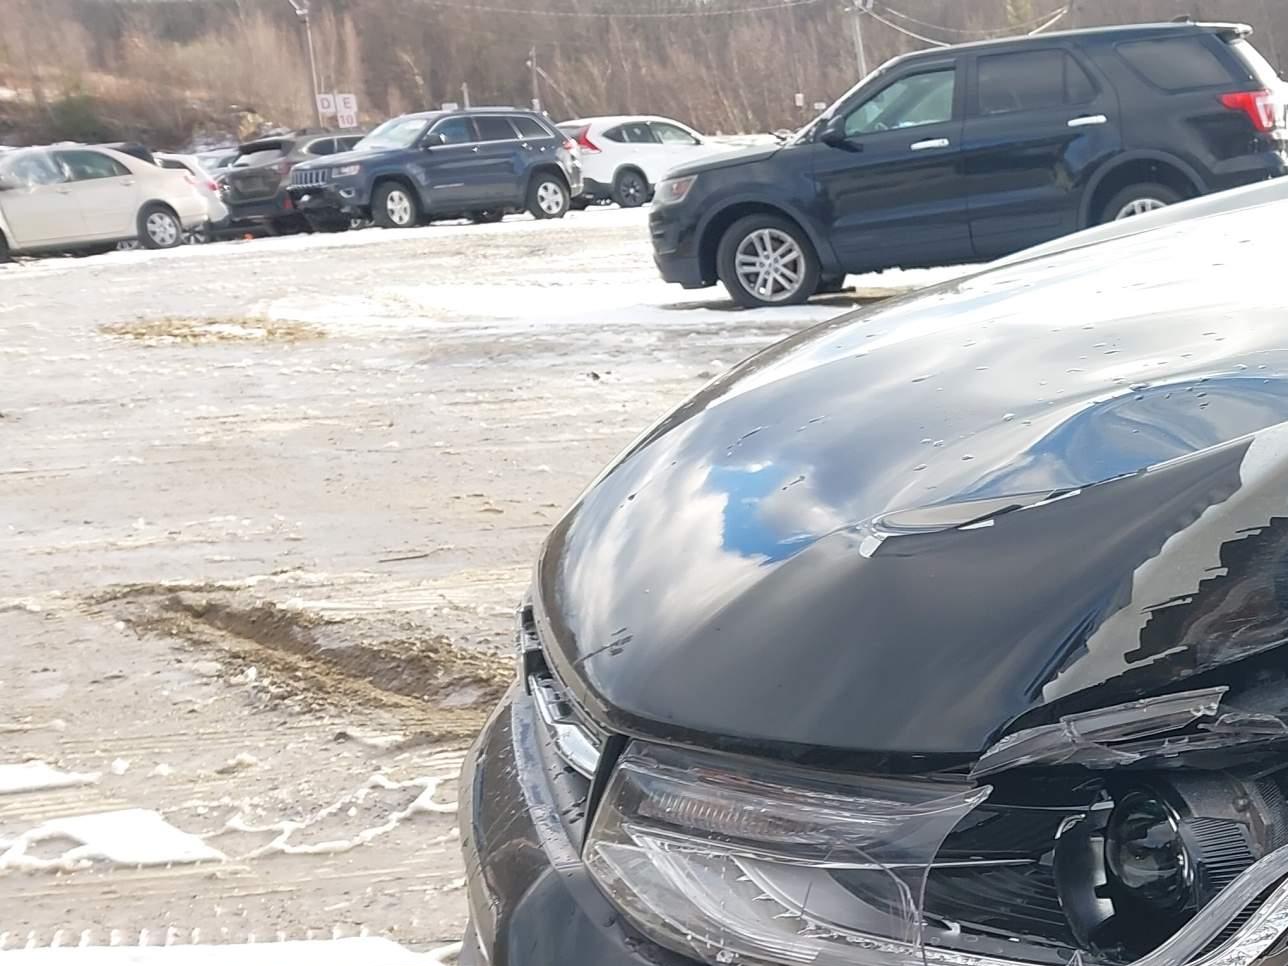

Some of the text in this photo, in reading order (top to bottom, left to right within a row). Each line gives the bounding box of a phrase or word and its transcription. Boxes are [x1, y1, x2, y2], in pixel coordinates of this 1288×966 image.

[320, 97, 331, 110] D
[342, 96, 352, 110] E
[340, 114, 355, 126] 10
